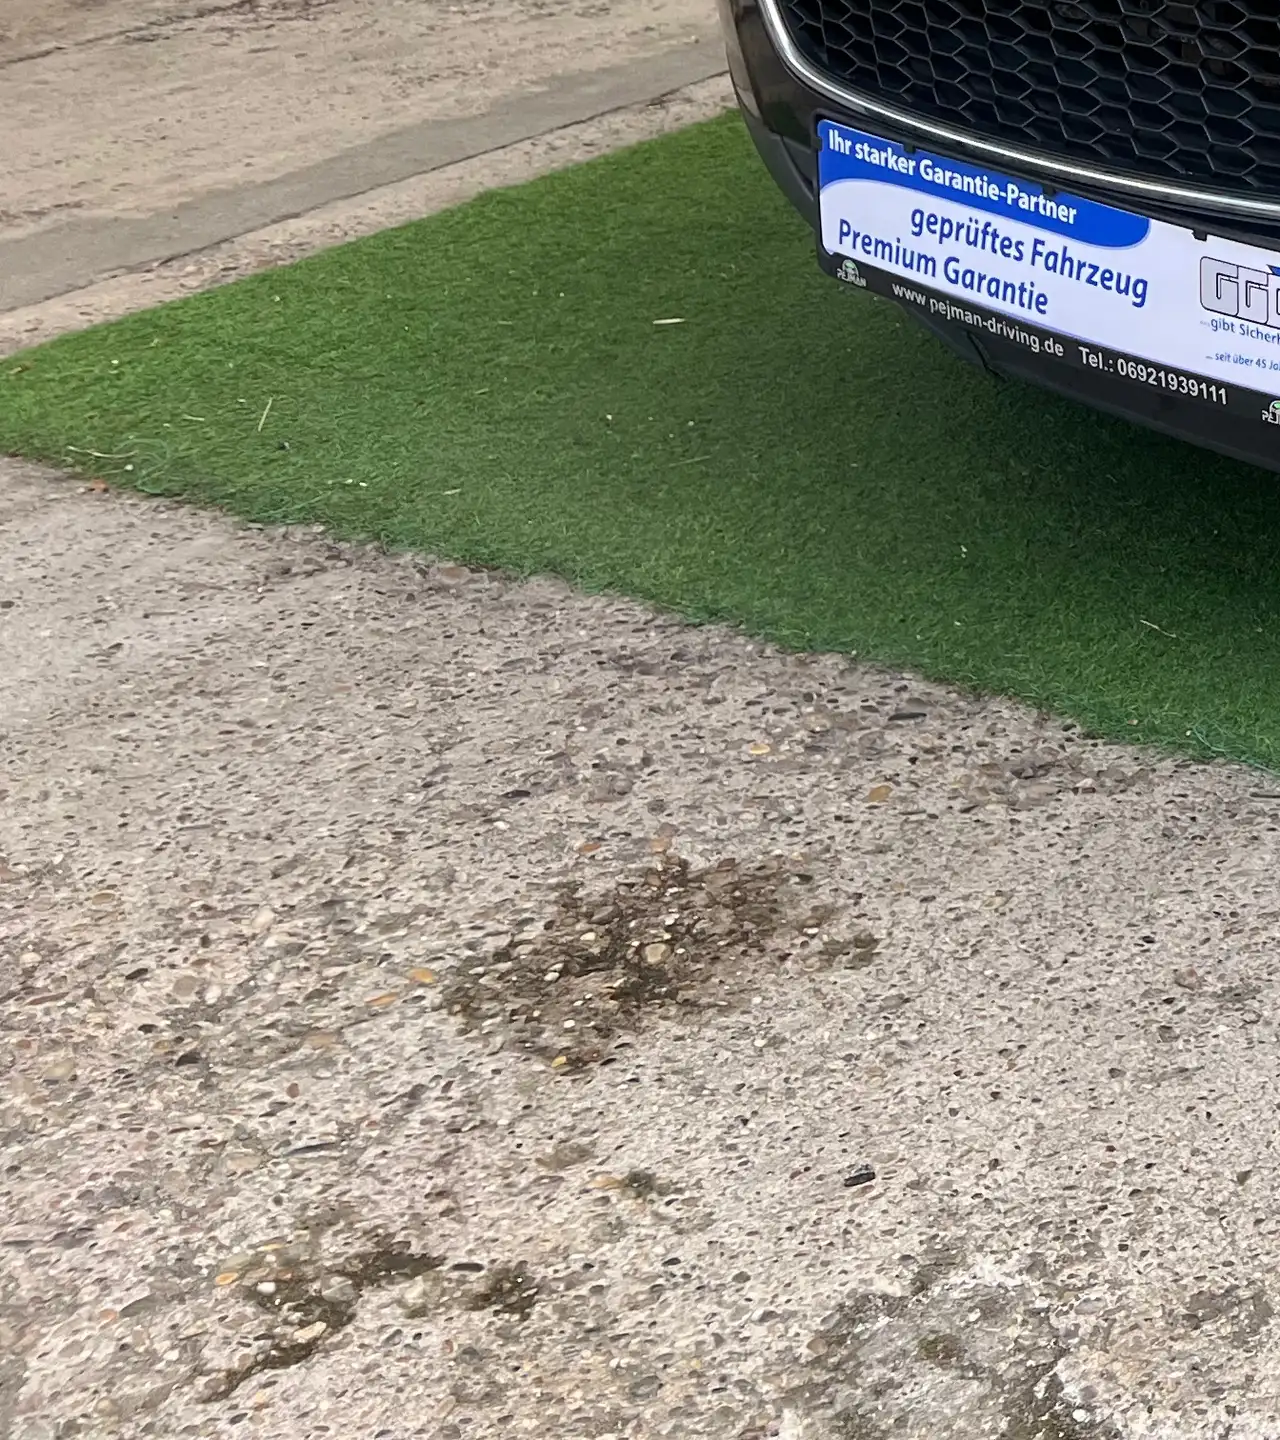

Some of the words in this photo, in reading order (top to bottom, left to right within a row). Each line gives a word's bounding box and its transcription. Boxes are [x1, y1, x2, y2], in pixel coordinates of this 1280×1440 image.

[828, 129, 852, 156] Ihr
[855, 142, 917, 176] starker
[919, 159, 1077, 224] Garantie-Partner
[839, 219, 936, 278] Premium
[943, 256, 1048, 314] Garantie
[911, 208, 1025, 262] geprüftes
[1030, 238, 1148, 308] Fahrzeug
[1078, 346, 1114, 373] Tel.:
[1117, 358, 1228, 406] 06921939111
[1233, 353, 1253, 366] über
[1255, 357, 1267, 369] 45
